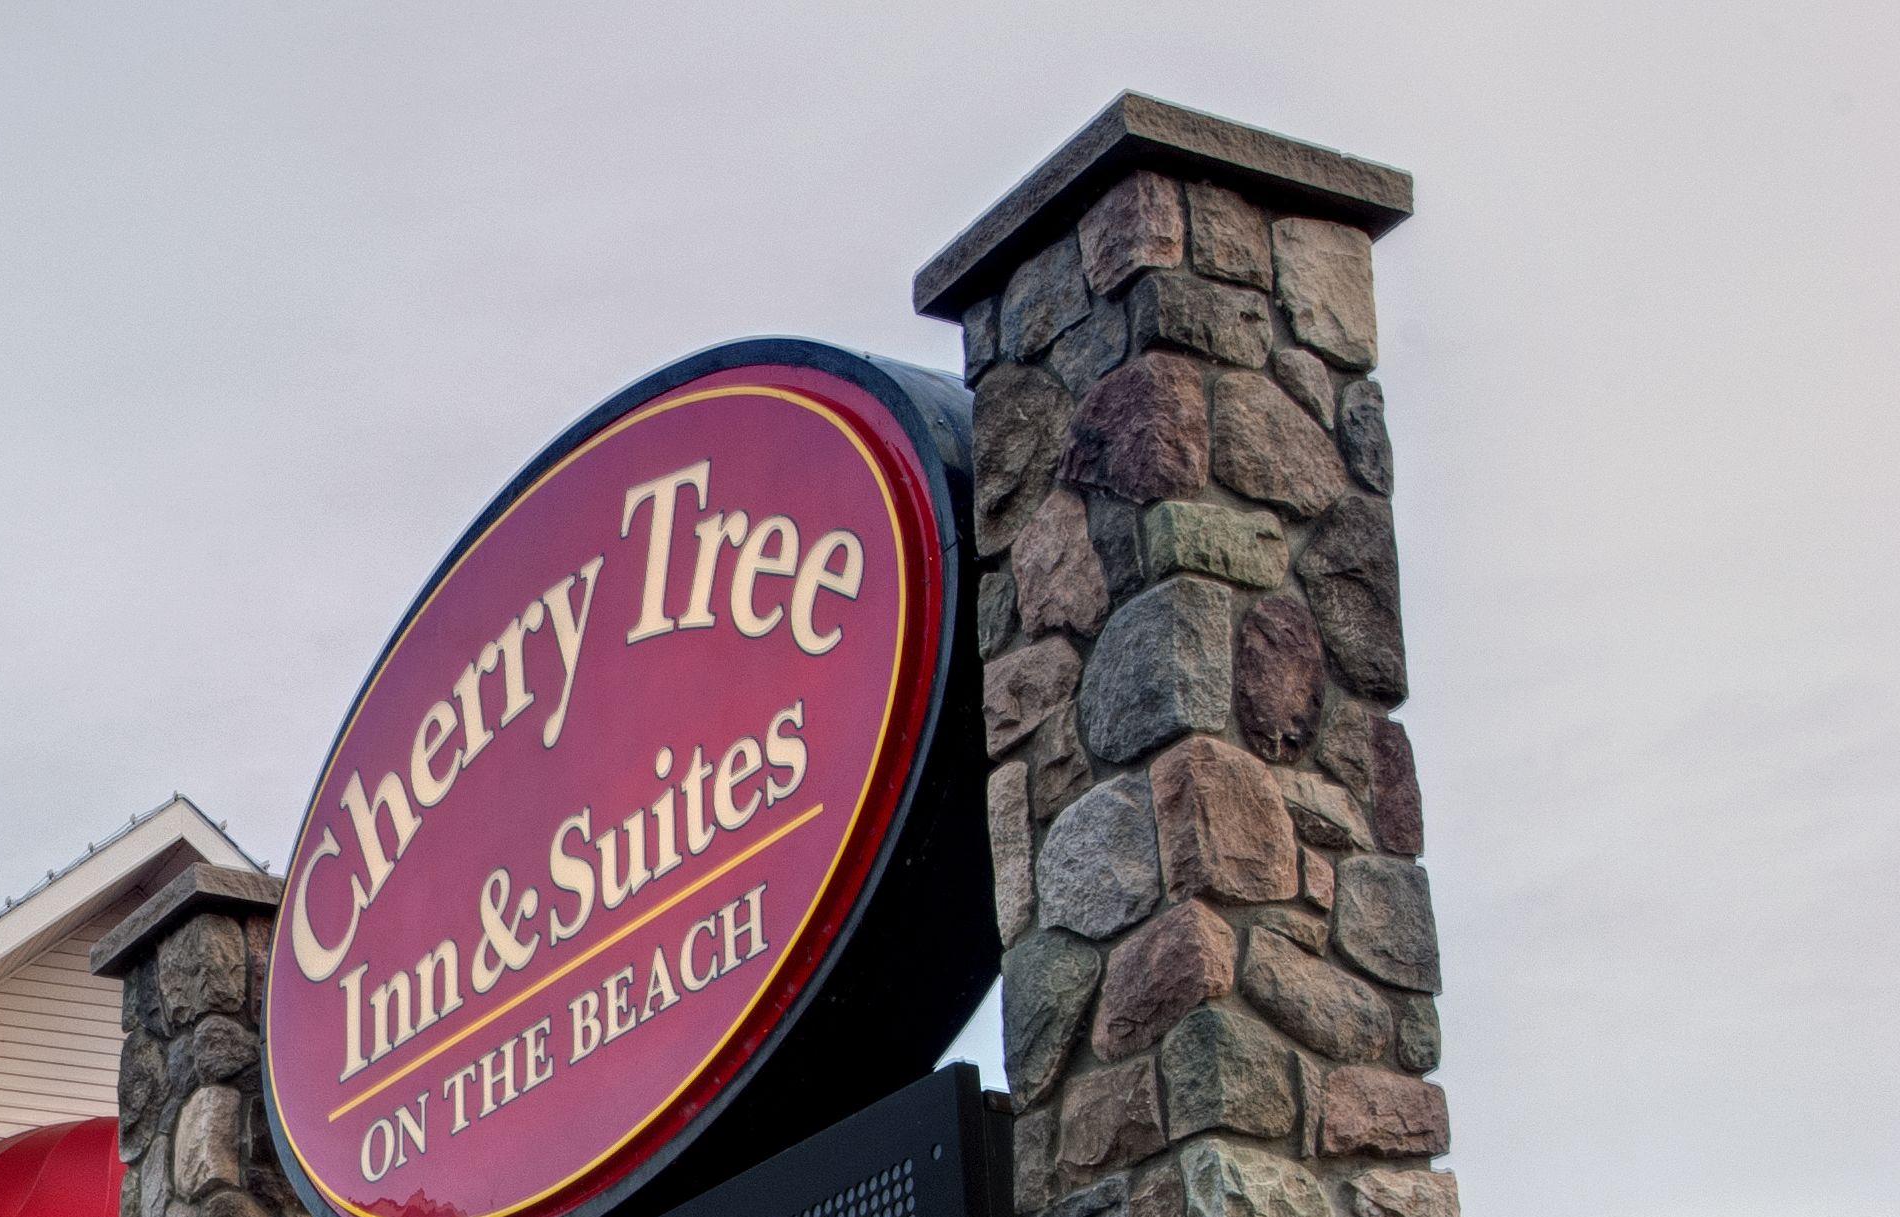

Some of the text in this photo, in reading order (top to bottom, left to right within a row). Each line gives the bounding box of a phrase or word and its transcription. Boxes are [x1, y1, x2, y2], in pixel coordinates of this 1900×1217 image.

[290, 459, 865, 982] Cherry Tree
[359, 883, 771, 1183] ON THE BEACH
